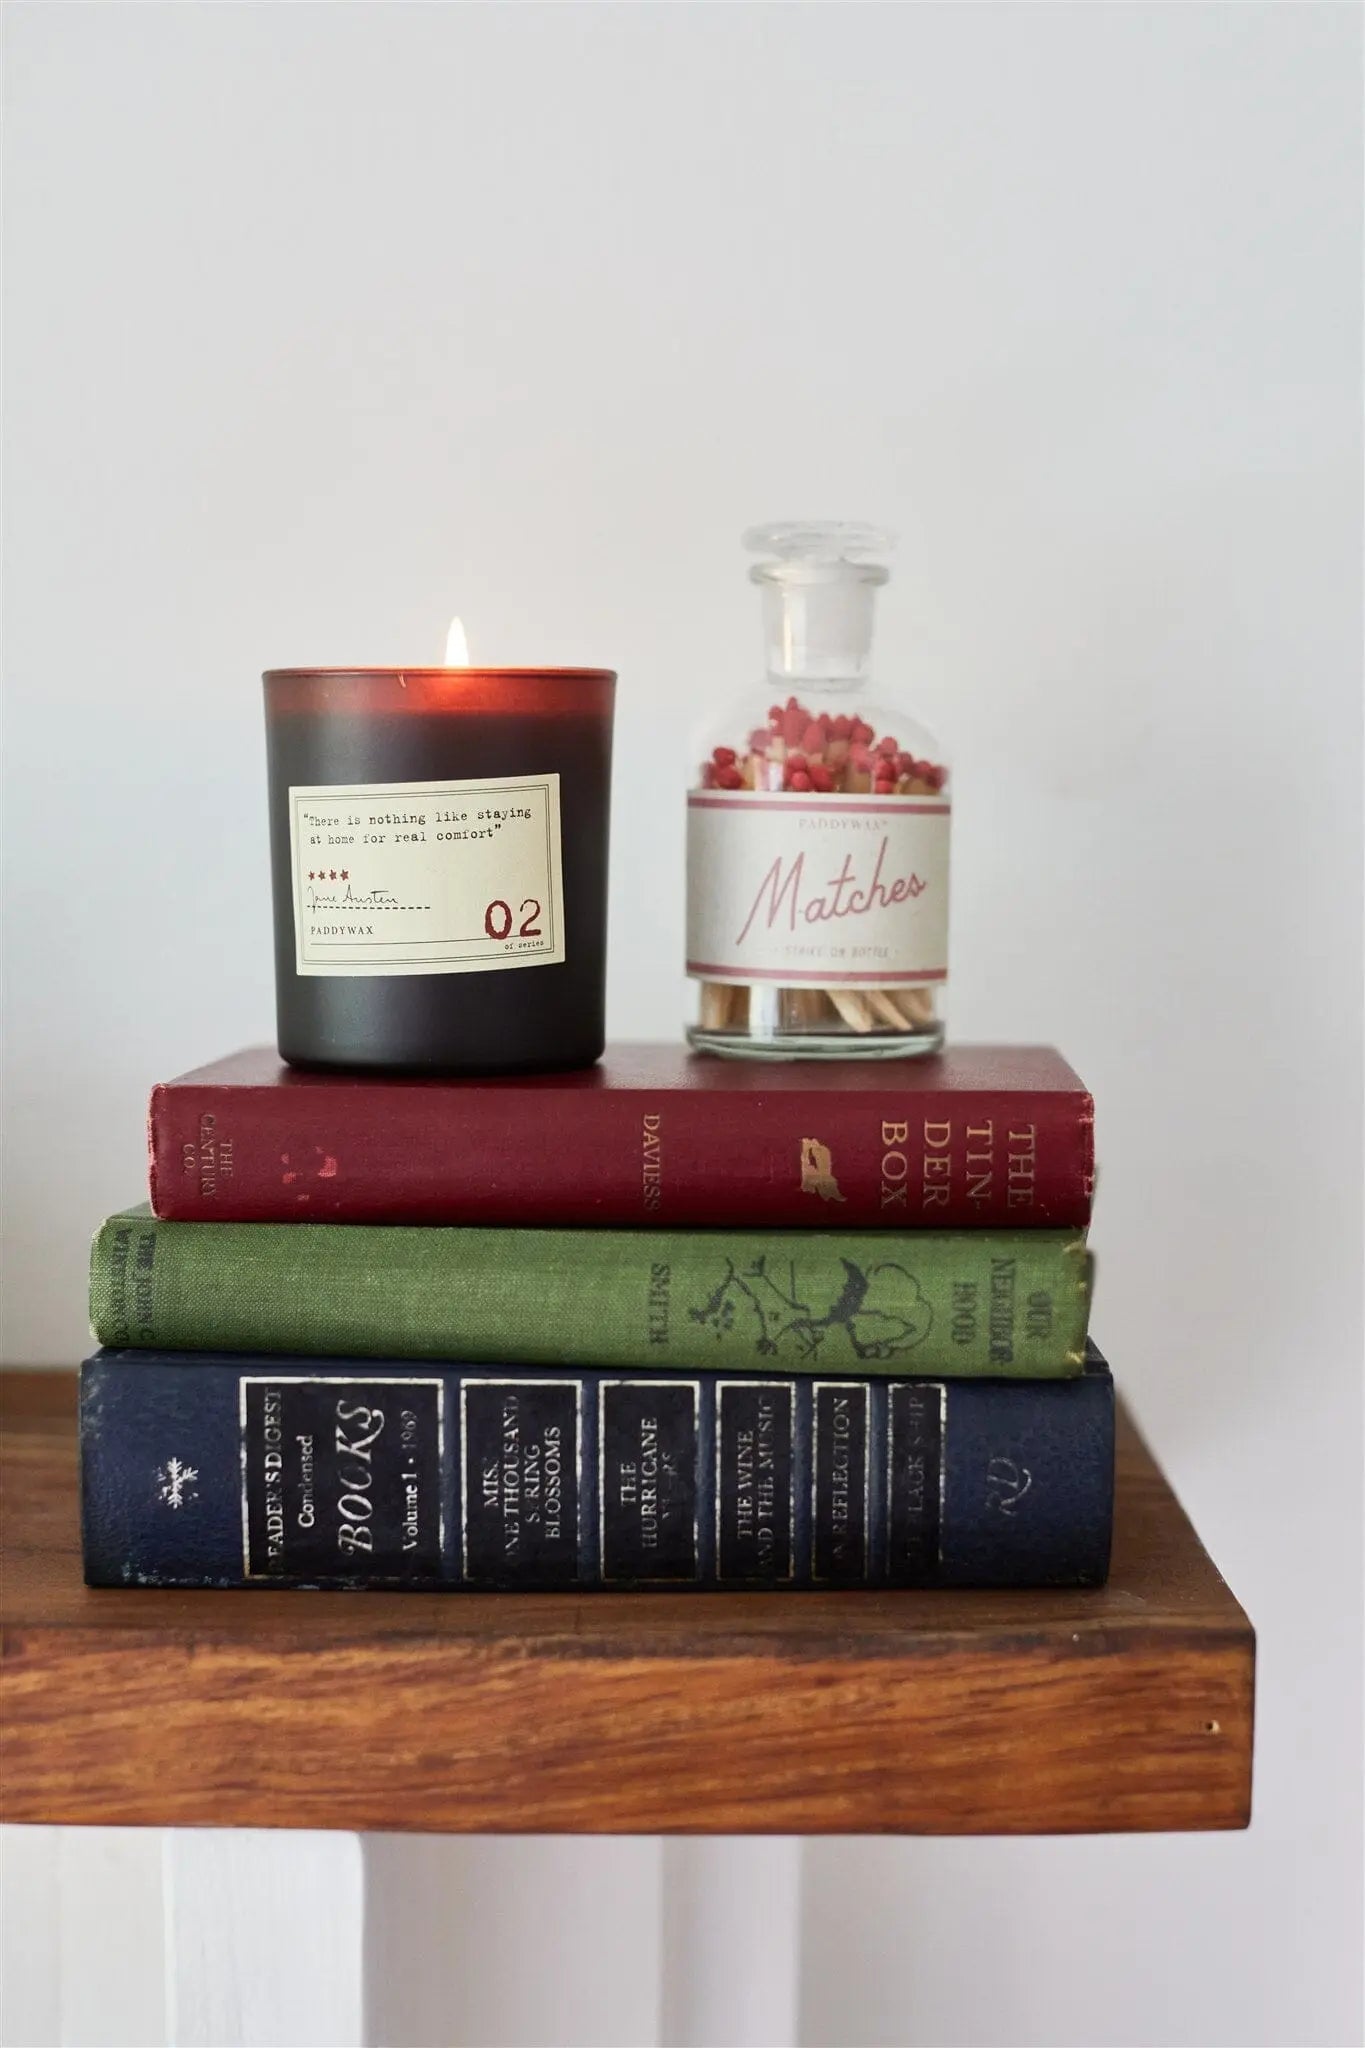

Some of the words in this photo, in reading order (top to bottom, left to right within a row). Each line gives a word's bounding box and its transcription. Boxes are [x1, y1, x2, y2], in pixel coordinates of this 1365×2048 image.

[310, 834, 322, 845] at
[327, 833, 355, 845] home
[363, 832, 386, 844] for
[394, 831, 427, 843] real
[347, 815, 361, 826] is
[369, 812, 427, 829] nothing
[435, 809, 468, 822] like
[477, 807, 532, 822] staying
[307, 885, 337, 914] Jane
[342, 884, 399, 905] Austen
[484, 898, 542, 940] 02
[735, 836, 929, 947] Matches
[310, 925, 375, 936] PADDYWAX
[504, 942, 515, 951] of
[518, 940, 545, 950] series
[200, 1113, 217, 1199] CENTURY
[220, 1138, 234, 1178] THE
[642, 1113, 662, 1212] DAVIESS
[881, 1120, 908, 1208] BOX
[922, 1119, 951, 1208] DER
[1007, 1123, 1036, 1208] THE
[649, 1263, 671, 1345] SMITH
[263, 1387, 282, 1468] DIGEST
[737, 1429, 754, 1490] WINE
[296, 1434, 315, 1528] Condensed
[336, 1399, 385, 1556] BOOKS
[483, 1458, 500, 1507] MIS
[525, 1443, 541, 1523] SRING
[545, 1426, 561, 1538] BLOSSOMS
[621, 1461, 637, 1506] THE
[642, 1416, 658, 1549] HURRICANE
[757, 1476, 773, 1519] THE
[833, 1397, 850, 1535] REFLECTION
[907, 1455, 925, 1524] LACK
[264, 1471, 283, 1569] EADER'S
[402, 1484, 419, 1550] Volume
[504, 1523, 520, 1558] NE
[737, 1495, 754, 1539] THE
